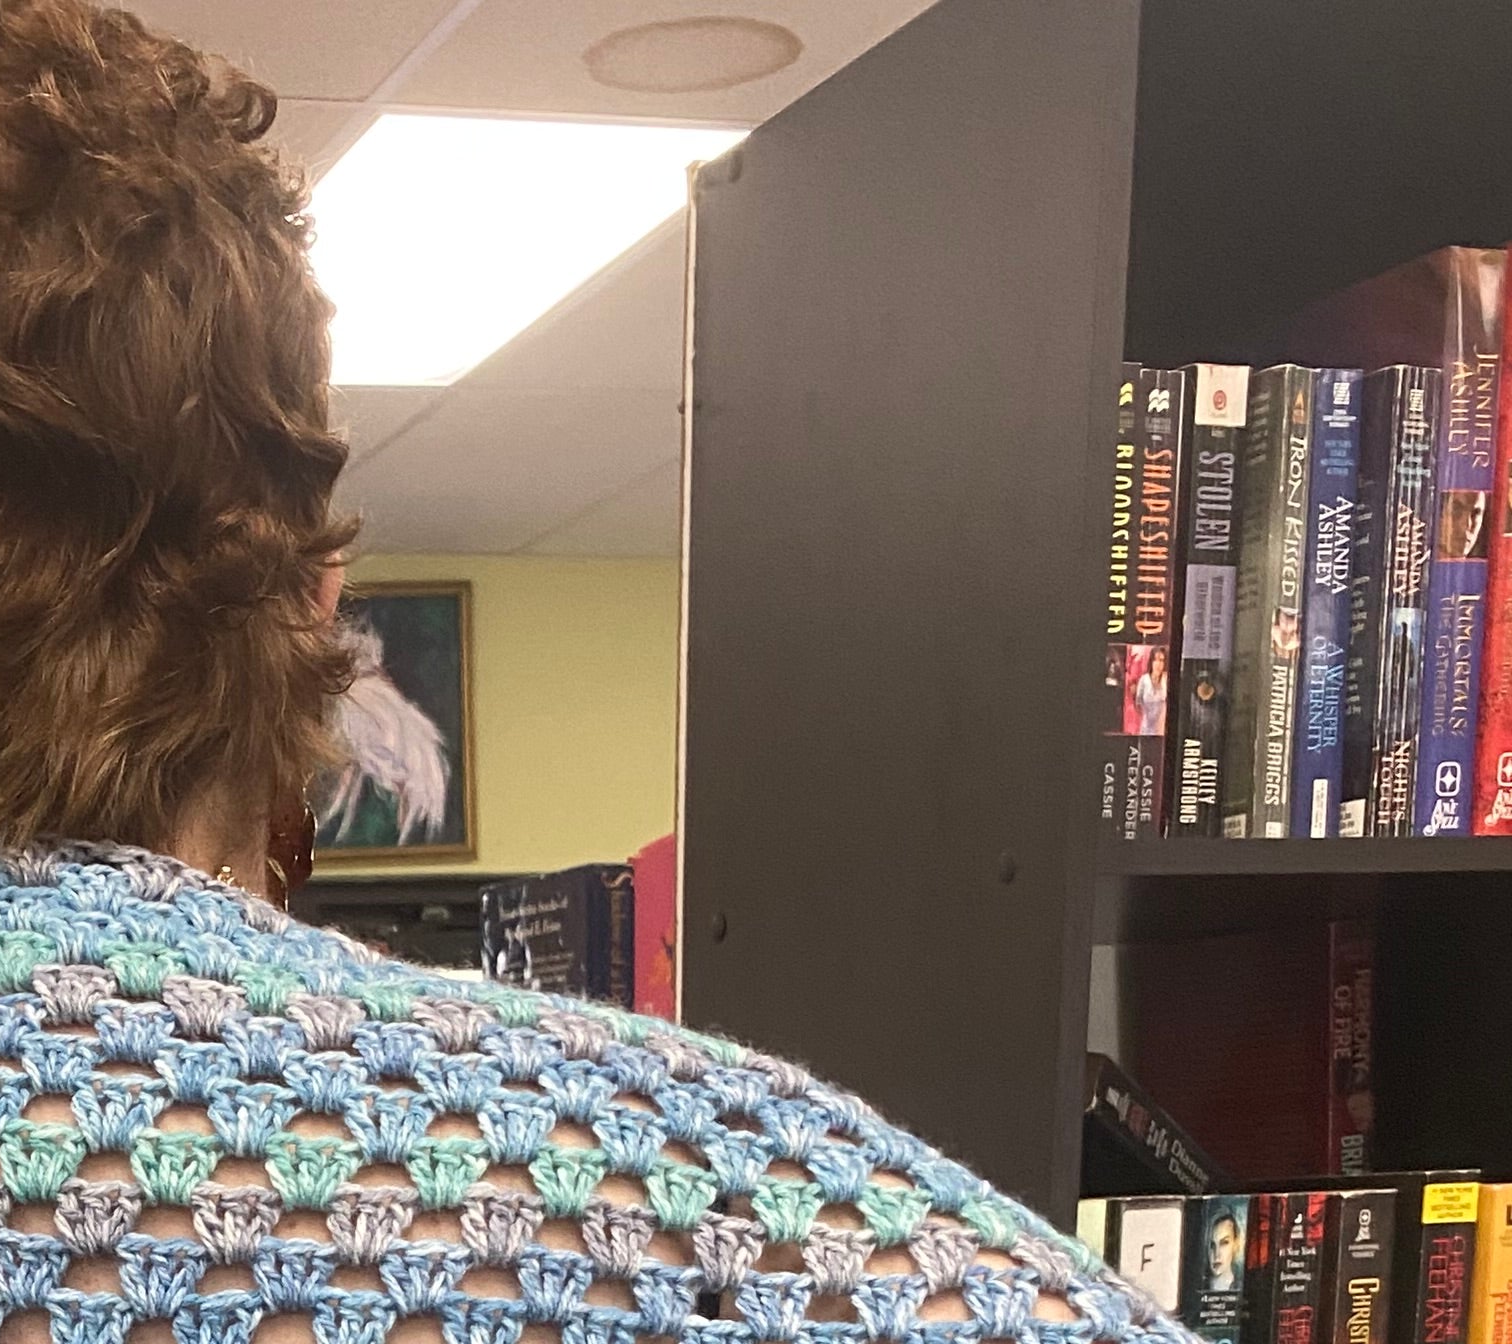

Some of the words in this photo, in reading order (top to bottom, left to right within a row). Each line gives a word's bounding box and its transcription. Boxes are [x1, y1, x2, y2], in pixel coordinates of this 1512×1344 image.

[1447, 360, 1474, 458] ASHLEY
[1471, 348, 1500, 468] JENNIFER
[1194, 450, 1235, 551] STOLEN
[1286, 434, 1306, 508] IRON
[1135, 447, 1173, 637] SHAPESHIFTED
[1281, 516, 1303, 597] KISSED
[1315, 503, 1336, 588] ASHLEY
[1331, 496, 1354, 594] AMANDA
[1393, 503, 1414, 597] ASHLEY
[1406, 517, 1426, 594] AMANDA
[1310, 635, 1327, 661] OF
[1326, 640, 1344, 658] A
[1267, 664, 1289, 736] PATRICIA
[1307, 664, 1328, 754] ETERNITY
[1322, 664, 1345, 748] WHISPER
[1103, 763, 1115, 819] CASSIE
[1125, 745, 1140, 840] ALEXANDER
[1141, 764, 1153, 823] CASSIE
[1179, 738, 1201, 824] ARMSTRONG
[1199, 759, 1217, 805] KELLEY
[1264, 741, 1287, 805] BRIGGS
[1333, 1017, 1352, 1061] FIRE
[1340, 1133, 1364, 1177] BRIA
[1424, 1237, 1452, 1343] FEEHAN
[1446, 1235, 1466, 1336] CHRISTINE
